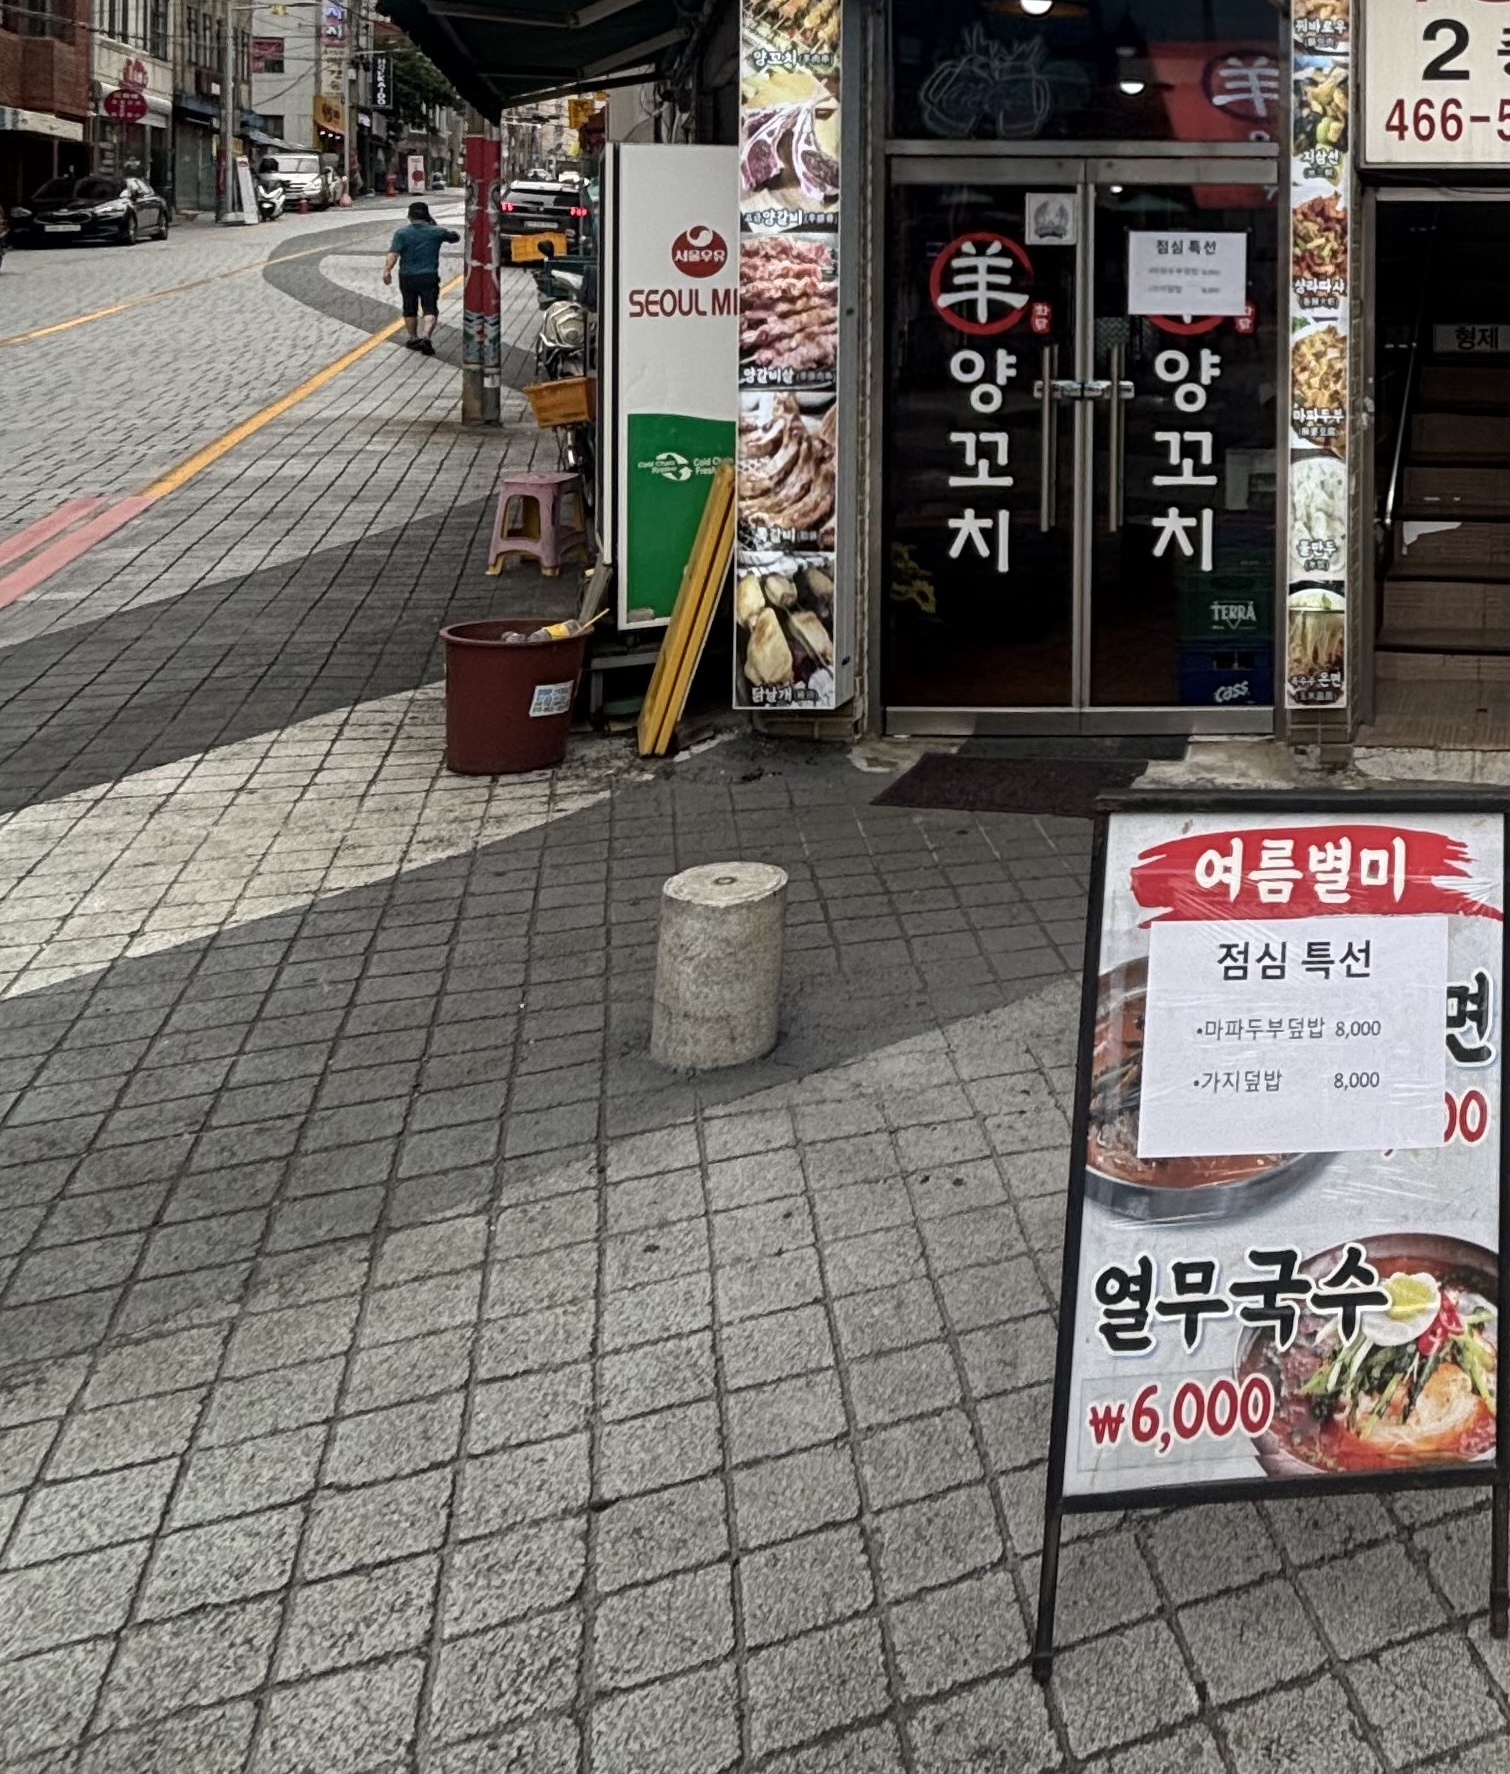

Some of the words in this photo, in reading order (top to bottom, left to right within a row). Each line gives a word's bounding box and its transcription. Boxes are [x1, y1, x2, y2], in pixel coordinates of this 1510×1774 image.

[754, 49, 797, 68] 양꼬치
[674, 248, 726, 264] 서울우유
[937, 240, 1030, 324] 羊
[629, 288, 708, 319] SEOUL
[1455, 326, 1498, 351] 형제
[948, 347, 1018, 574] 양꼬치
[1152, 347, 1222, 573] 양꼬치
[1210, 601, 1257, 622] TERRA
[1194, 836, 1407, 906] 여름별미
[1216, 941, 1289, 982] 점심
[1300, 939, 1374, 980] 특선
[1334, 1019, 1381, 1040] 8,000
[1333, 1072, 1381, 1093] 8,000
[1094, 1243, 1392, 1356] 열무국수
